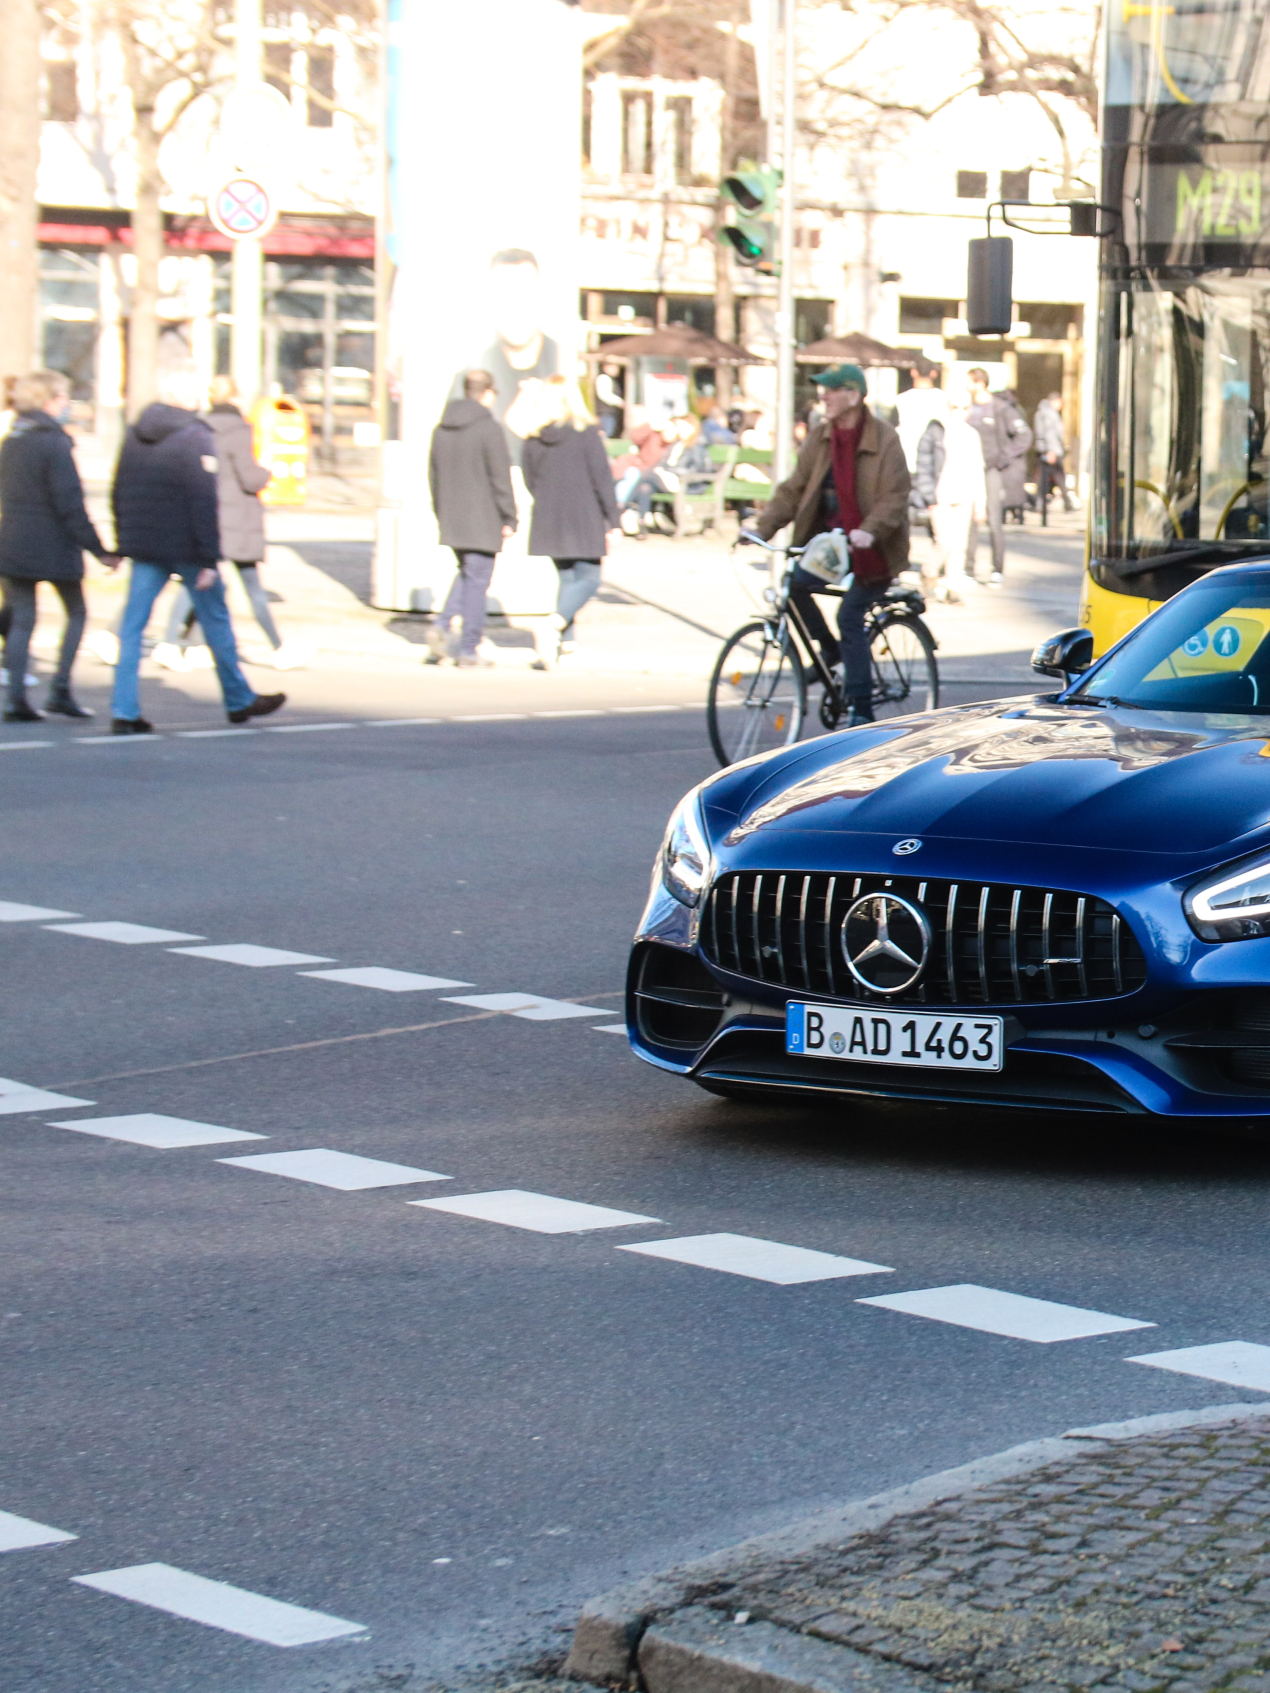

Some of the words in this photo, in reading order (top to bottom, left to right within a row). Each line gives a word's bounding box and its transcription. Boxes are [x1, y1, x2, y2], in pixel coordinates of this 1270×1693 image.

[1176, 169, 1262, 237] M29
[792, 1033, 800, 1045] D
[806, 1011, 824, 1049] B
[849, 1016, 892, 1055] AD
[901, 1020, 994, 1062] 1463
